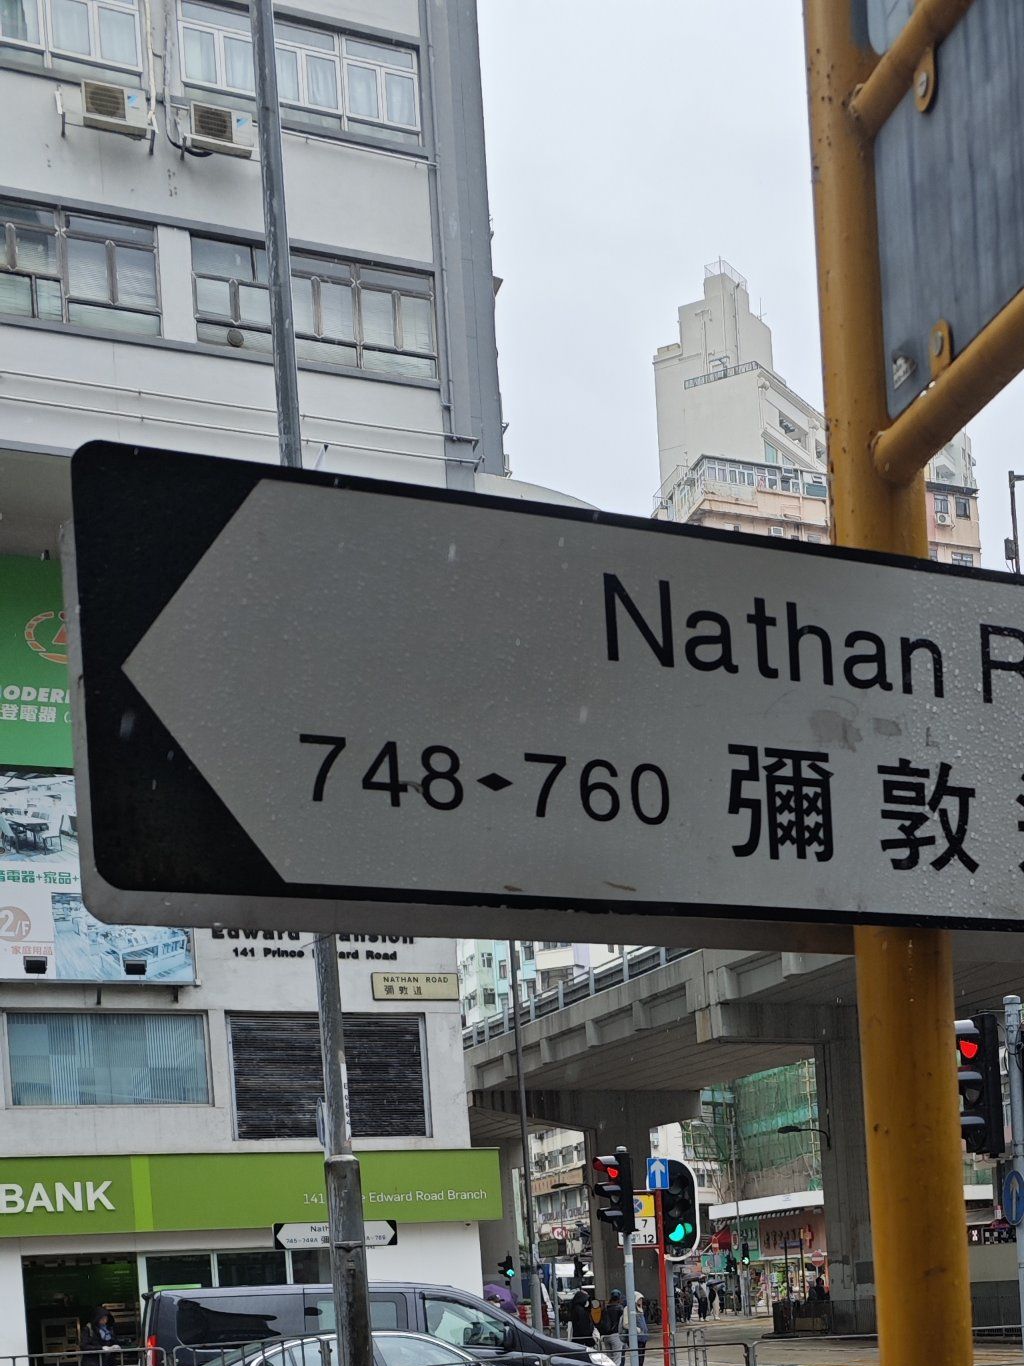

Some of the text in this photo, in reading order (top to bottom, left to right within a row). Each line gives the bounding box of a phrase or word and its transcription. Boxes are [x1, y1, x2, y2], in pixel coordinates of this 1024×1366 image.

[603, 572, 946, 698] Nathan
[0, 685, 70, 704] ODER
[0, 703, 56, 723] 登電器
[233, 947, 255, 958] 141
[366, 950, 397, 961] Road
[383, 975, 449, 984] NATHAN ROAD
[384, 985, 423, 996] 彌敦道
[0, 1180, 116, 1214] BANK
[303, 1193, 325, 1204] 141
[369, 1191, 413, 1203] Edward
[416, 1190, 445, 1201] Road
[447, 1188, 488, 1200] Branch
[643, 1234, 655, 1243] 12
